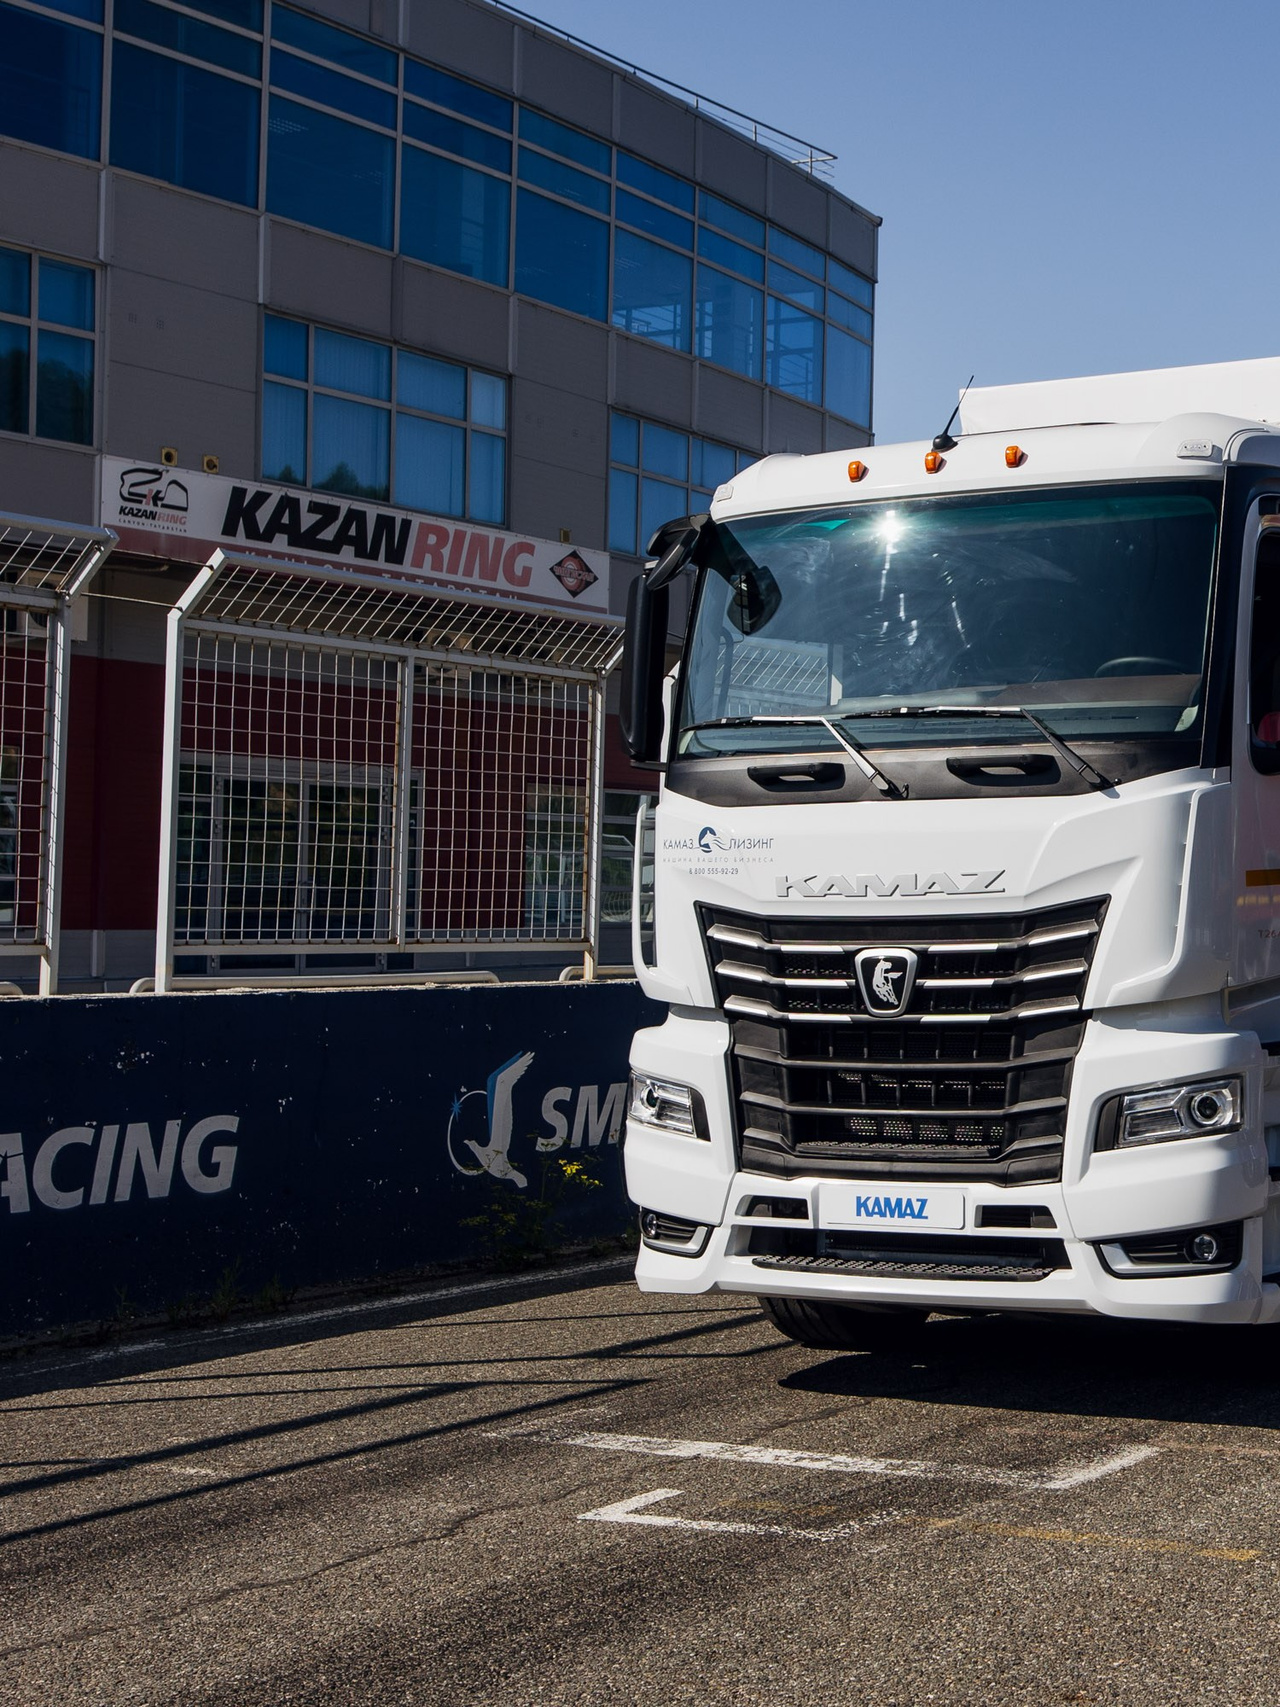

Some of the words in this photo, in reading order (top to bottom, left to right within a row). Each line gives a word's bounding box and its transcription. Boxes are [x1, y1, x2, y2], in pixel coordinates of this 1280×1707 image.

[663, 838, 694, 850] КАМАЗ
[728, 838, 775, 850] ЛИЗИНГ
[694, 867, 706, 875] 800
[707, 867, 739, 875] 555-92-29
[775, 869, 1006, 898] KAMAZ
[855, 1195, 929, 1220] KAMAZ
